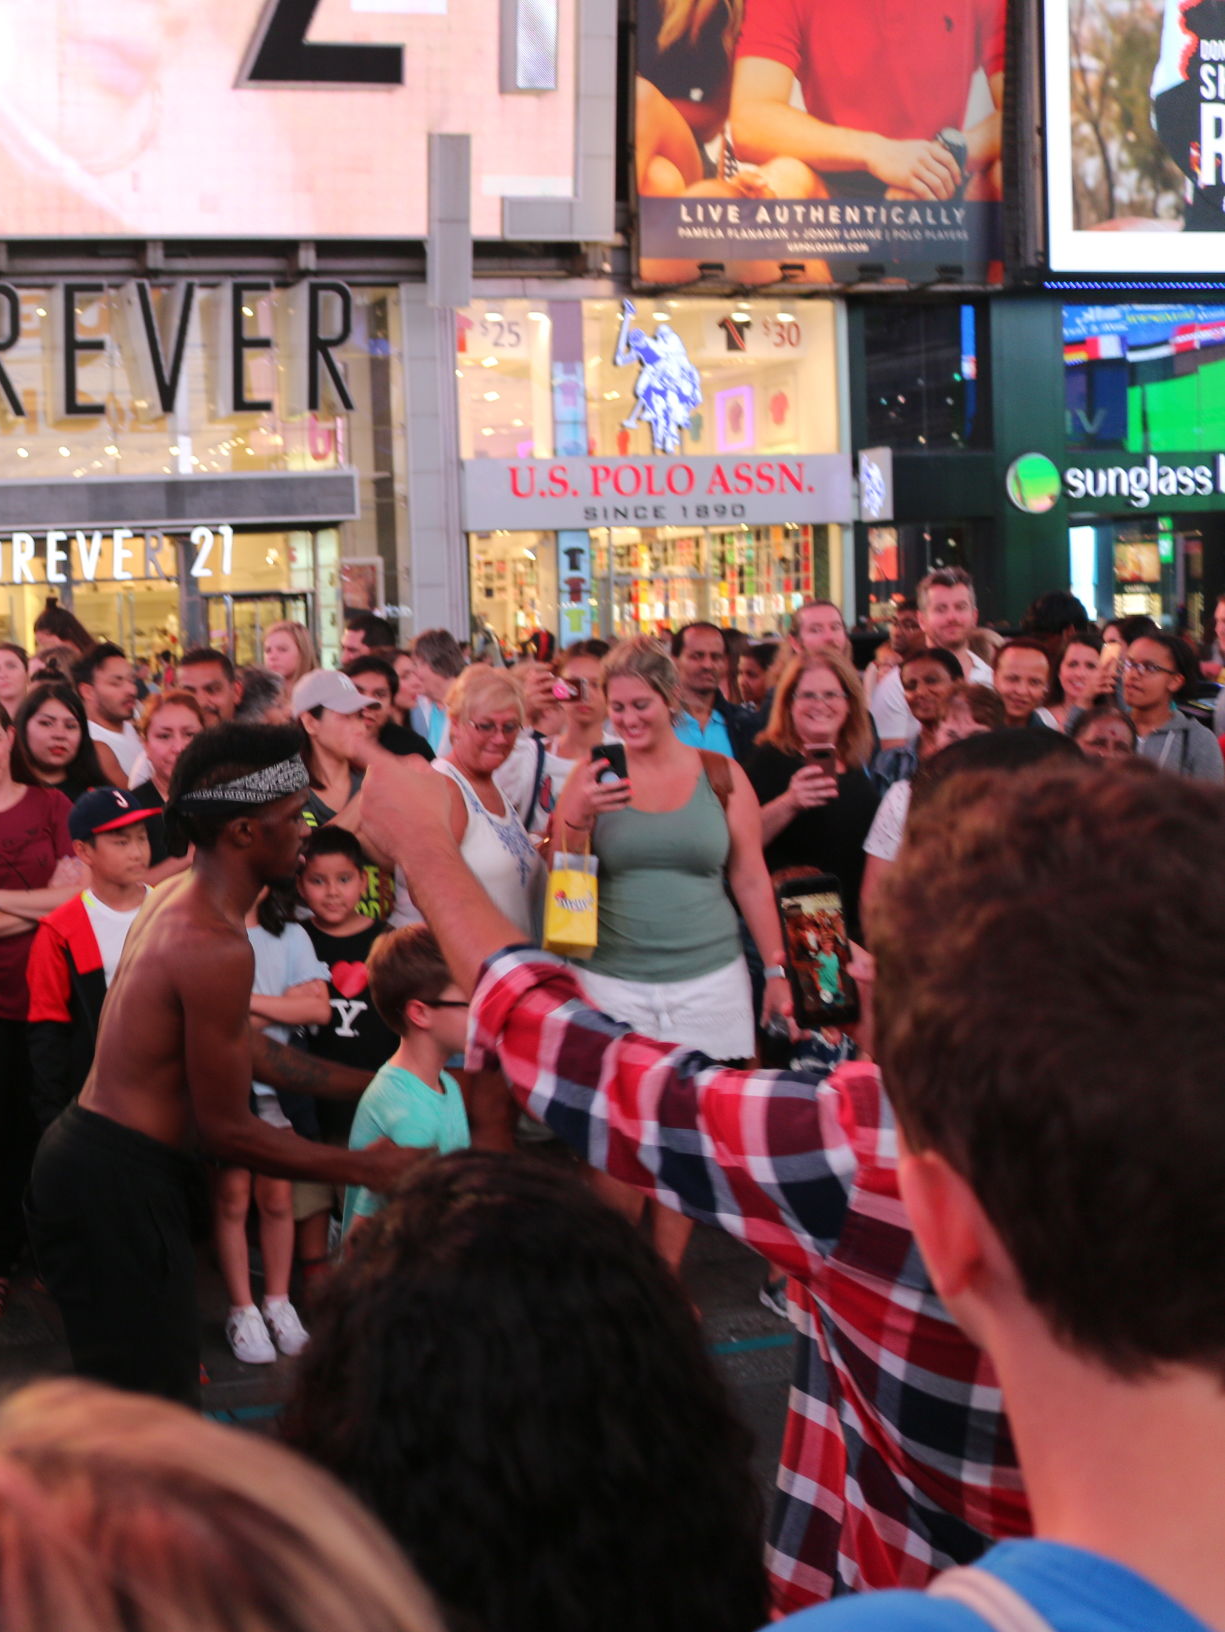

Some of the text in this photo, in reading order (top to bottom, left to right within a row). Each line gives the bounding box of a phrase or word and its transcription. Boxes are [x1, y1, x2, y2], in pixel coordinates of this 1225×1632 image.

[680, 204, 966, 226] LIVE AUTHENTICALLY
[480, 320, 522, 348] $25
[762, 319, 802, 348] $30
[508, 461, 815, 499] U.S. POLO ASSN.
[1065, 453, 1213, 509] sunglass
[584, 503, 747, 521] SINCE 1890
[190, 524, 234, 578] 21
